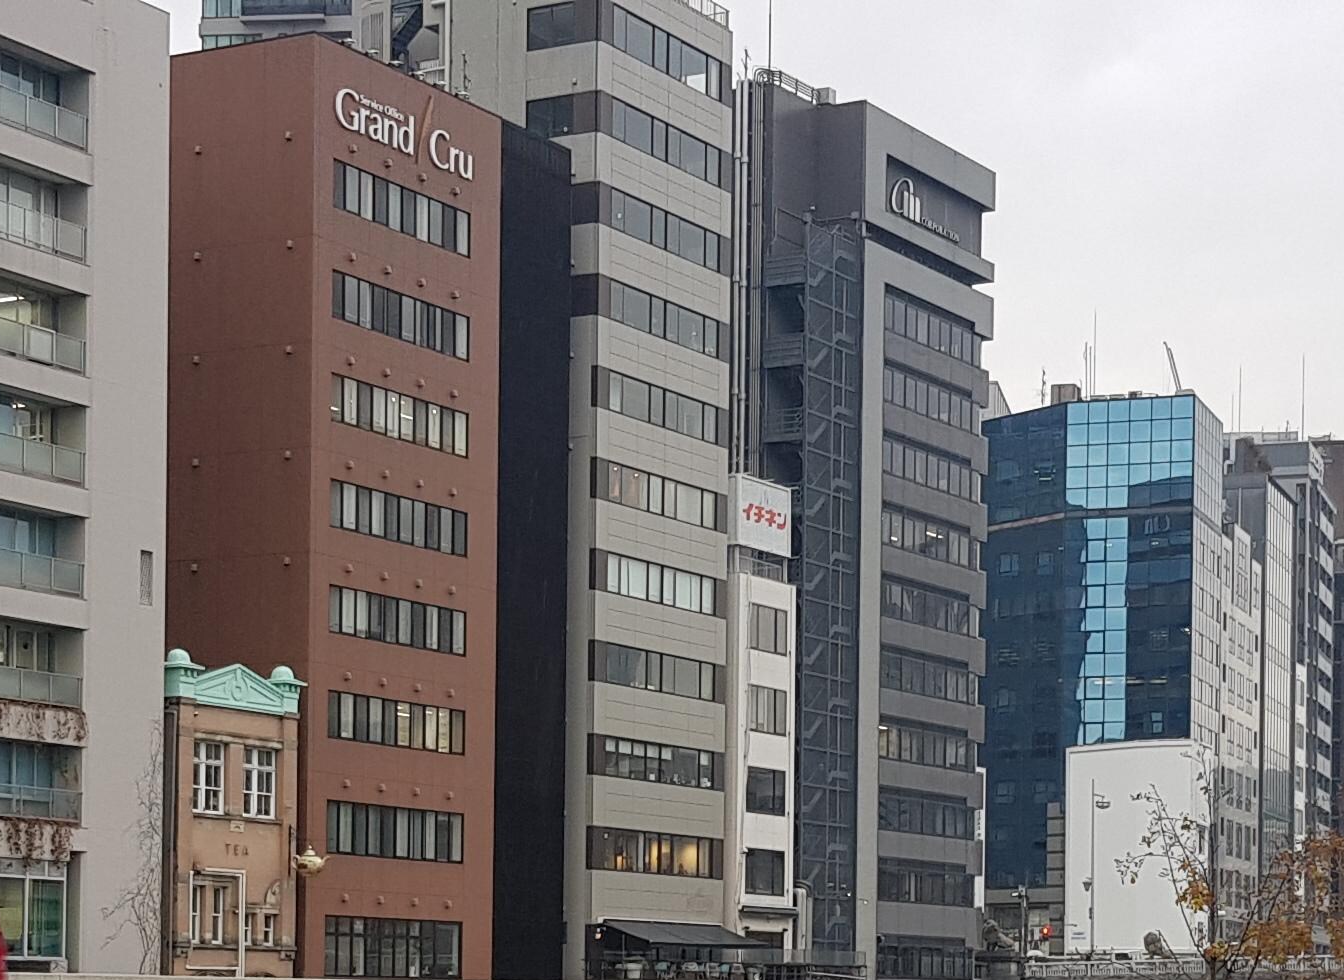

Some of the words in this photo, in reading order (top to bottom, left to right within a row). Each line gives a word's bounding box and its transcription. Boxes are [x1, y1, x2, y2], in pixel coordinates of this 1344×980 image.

[360, 95, 384, 113] Service
[385, 105, 405, 122] Office
[335, 88, 415, 156] Grand
[429, 129, 473, 181] Cru
[742, 503, 787, 530] イチネン
[224, 843, 249, 857] TEA
